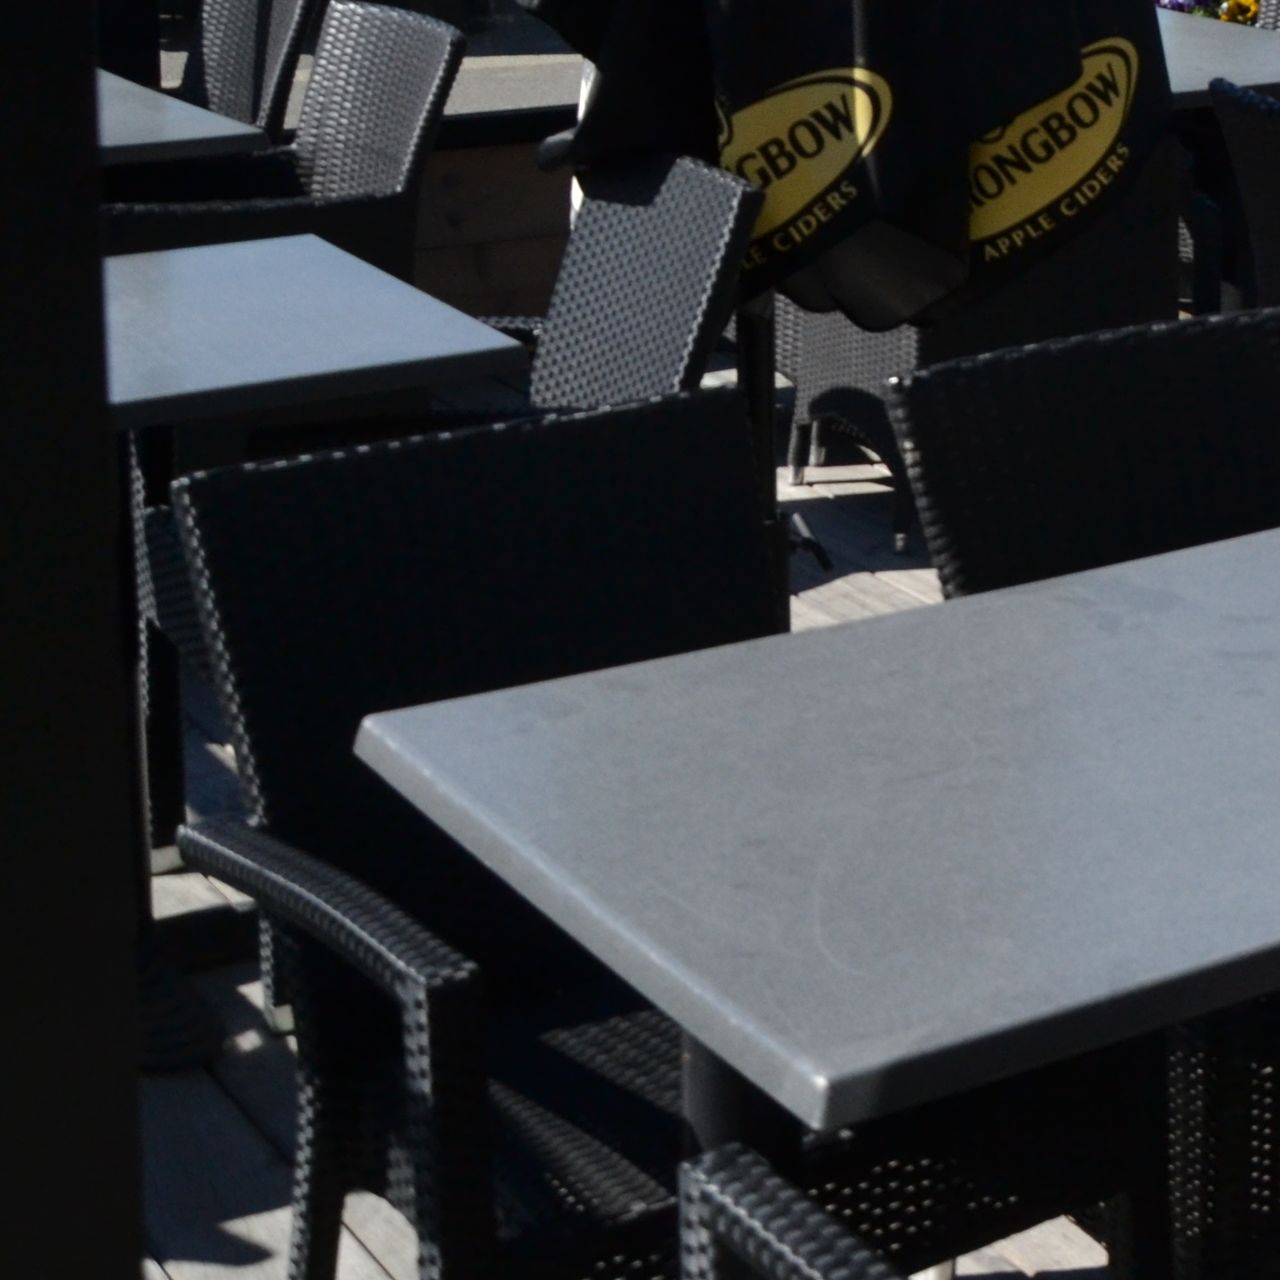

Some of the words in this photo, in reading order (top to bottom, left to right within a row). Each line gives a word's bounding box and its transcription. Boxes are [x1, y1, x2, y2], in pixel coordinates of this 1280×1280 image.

[727, 93, 857, 189] GBOW
[772, 180, 858, 253] CIDERS
[983, 214, 1057, 262] APPLE
[1059, 142, 1131, 217] CIDERS
